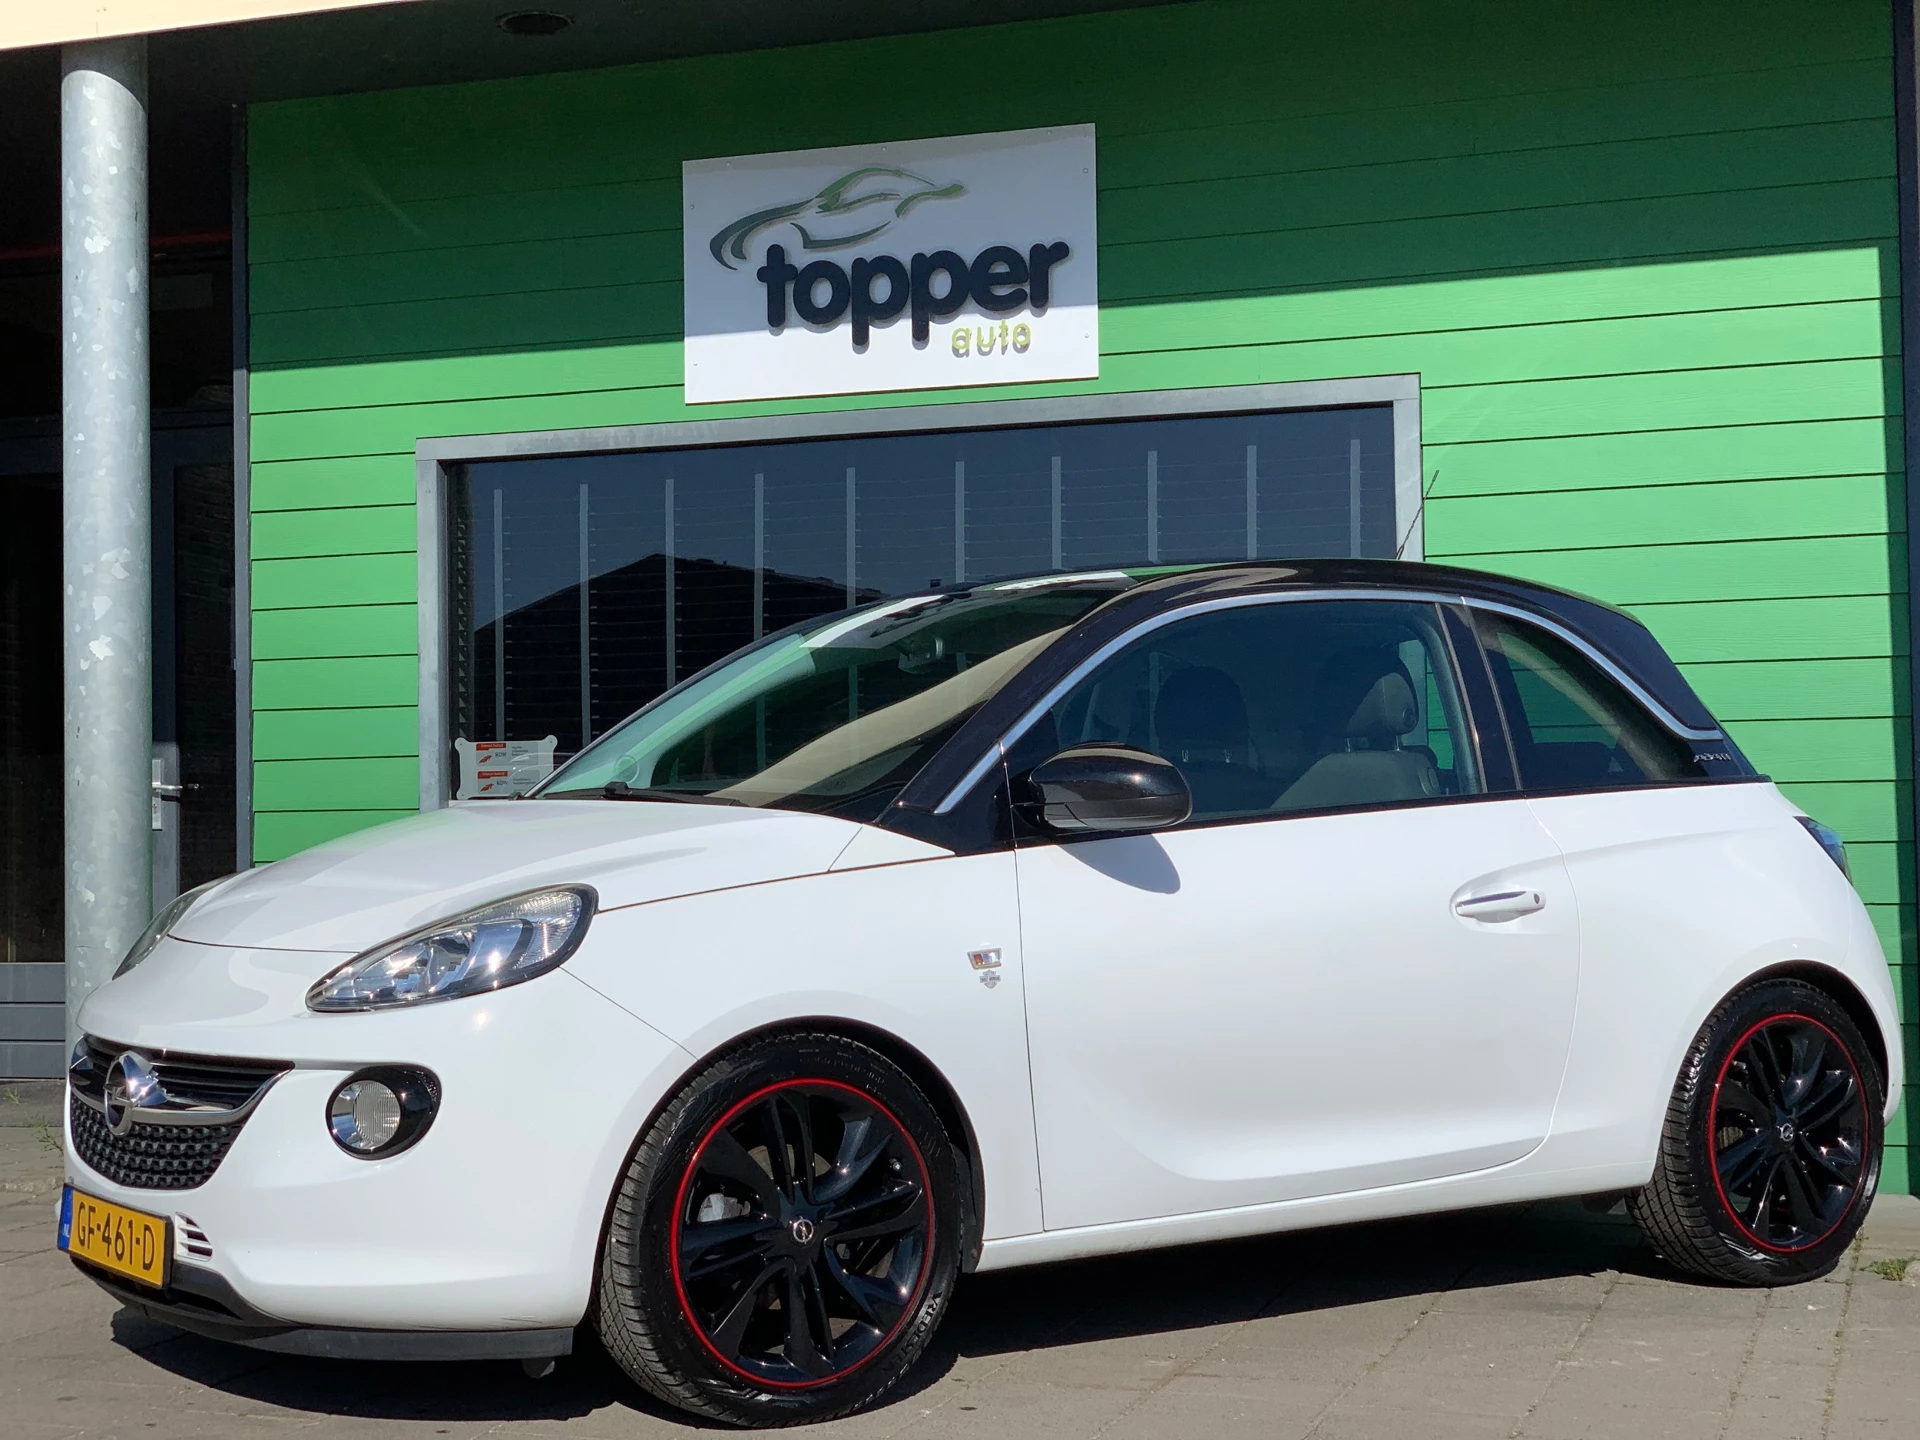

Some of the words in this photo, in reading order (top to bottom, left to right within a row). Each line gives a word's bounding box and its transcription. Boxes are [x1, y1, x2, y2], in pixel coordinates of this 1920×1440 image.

[757, 243, 1070, 346] topper
[951, 320, 1032, 350] auto
[62, 1223, 70, 1237] NL
[78, 1202, 154, 1271] GF-461-D
